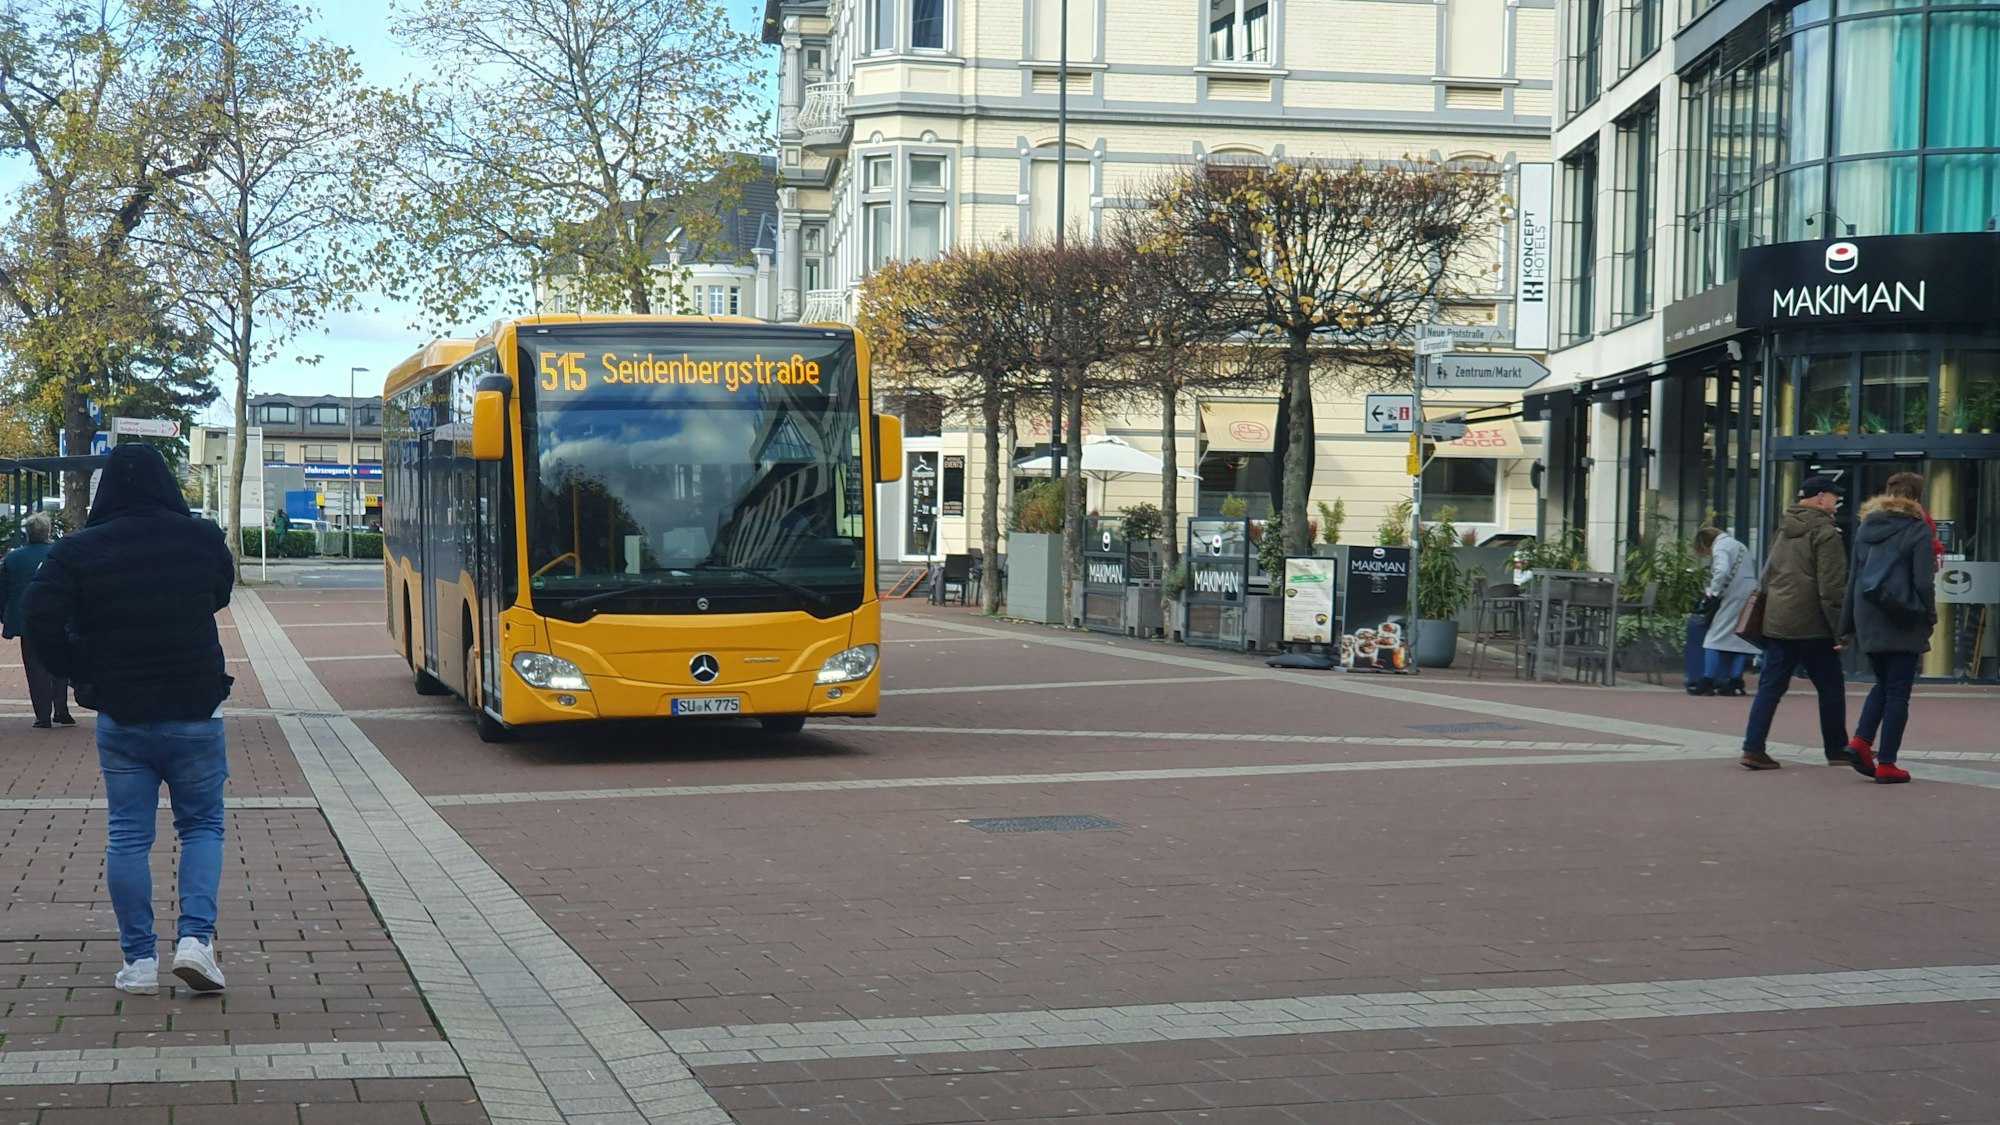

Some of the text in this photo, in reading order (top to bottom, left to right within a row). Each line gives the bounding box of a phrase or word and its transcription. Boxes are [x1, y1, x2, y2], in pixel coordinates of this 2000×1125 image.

[1523, 210, 1535, 278] KONCEPT
[1533, 225, 1546, 278] HOTELS
[1772, 279, 1926, 318] MAKIMAN
[1427, 328, 1445, 338] Neue
[539, 351, 820, 392] 515 Seidenbergstraße
[1455, 365, 1522, 378] Zentrum/Markt
[944, 460, 963, 469] EVENTS
[1088, 563, 1123, 584] MAKIMAN
[1351, 559, 1406, 573] MAKIMAN
[1194, 570, 1239, 593] MAKIMAN
[679, 698, 739, 712] SU K 775
